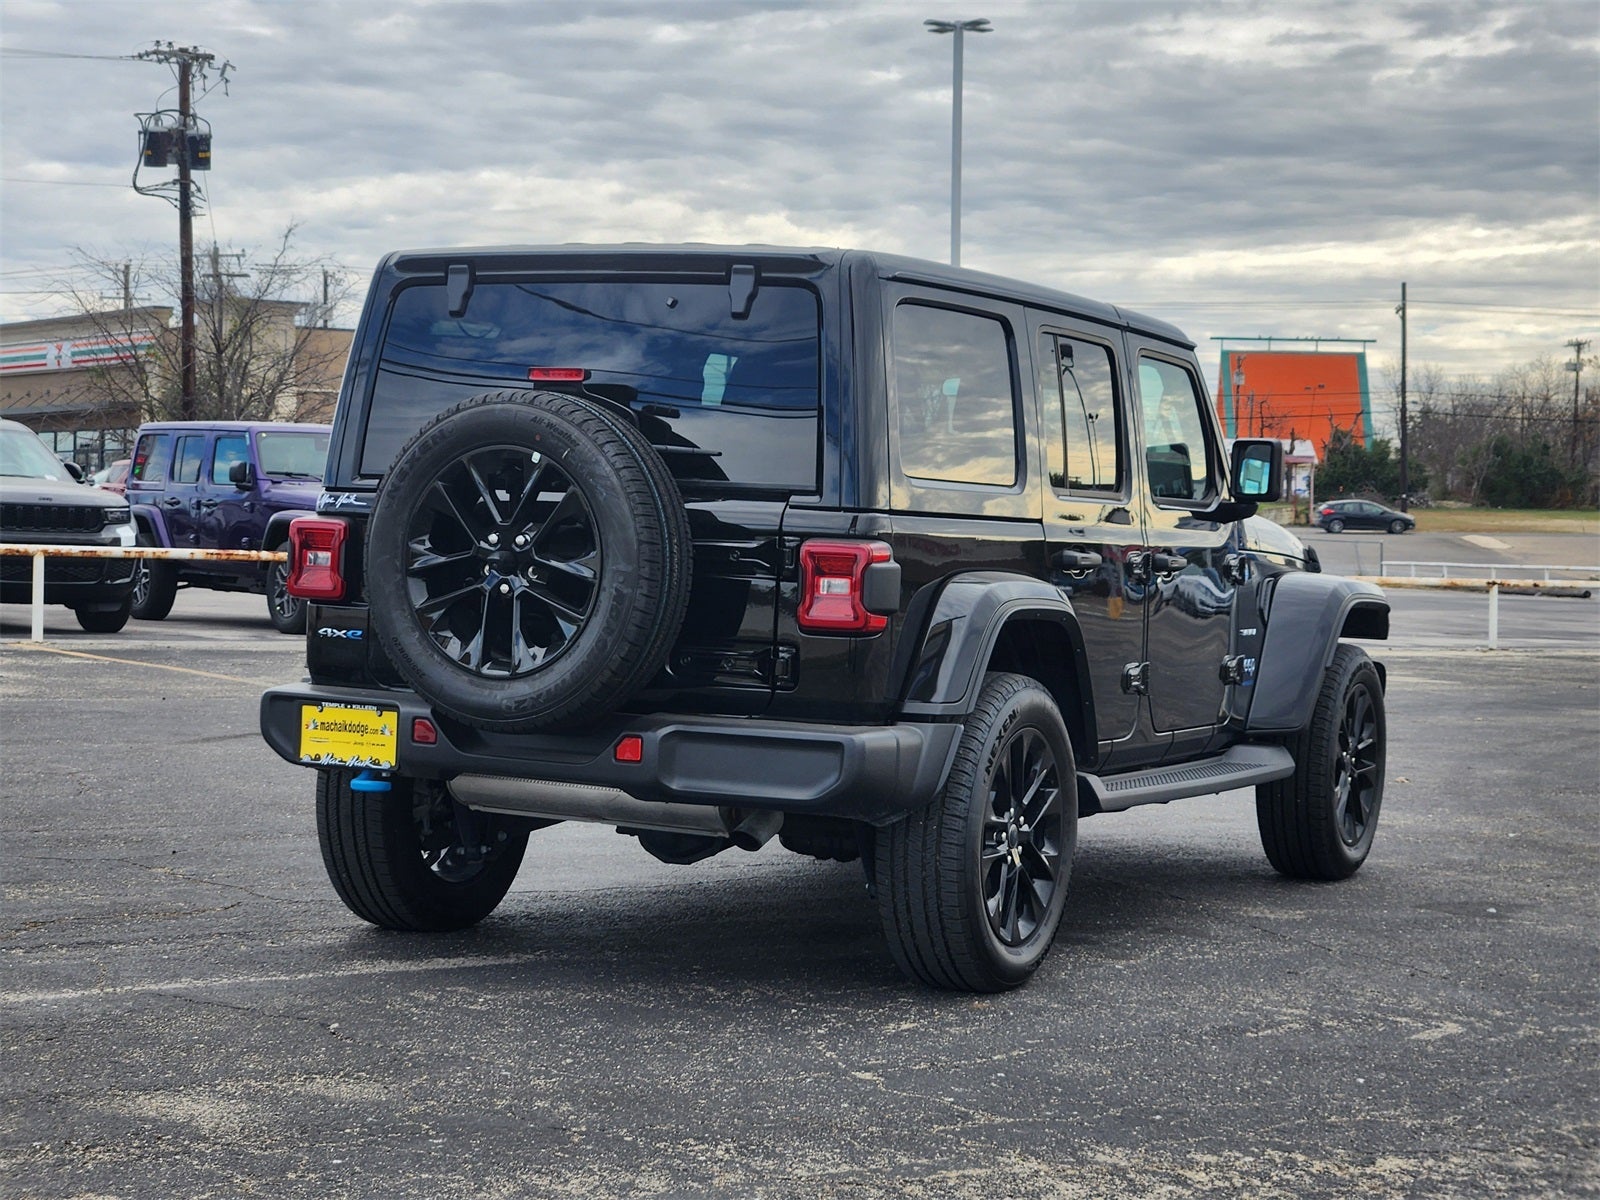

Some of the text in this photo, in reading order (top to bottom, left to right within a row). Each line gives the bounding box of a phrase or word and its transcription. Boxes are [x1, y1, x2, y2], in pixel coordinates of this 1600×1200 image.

[530, 416, 580, 448] All-Weather
[386, 428, 447, 500] NEXEN
[321, 701, 345, 709] TEMPLE
[984, 707, 1018, 776] NEXEN
